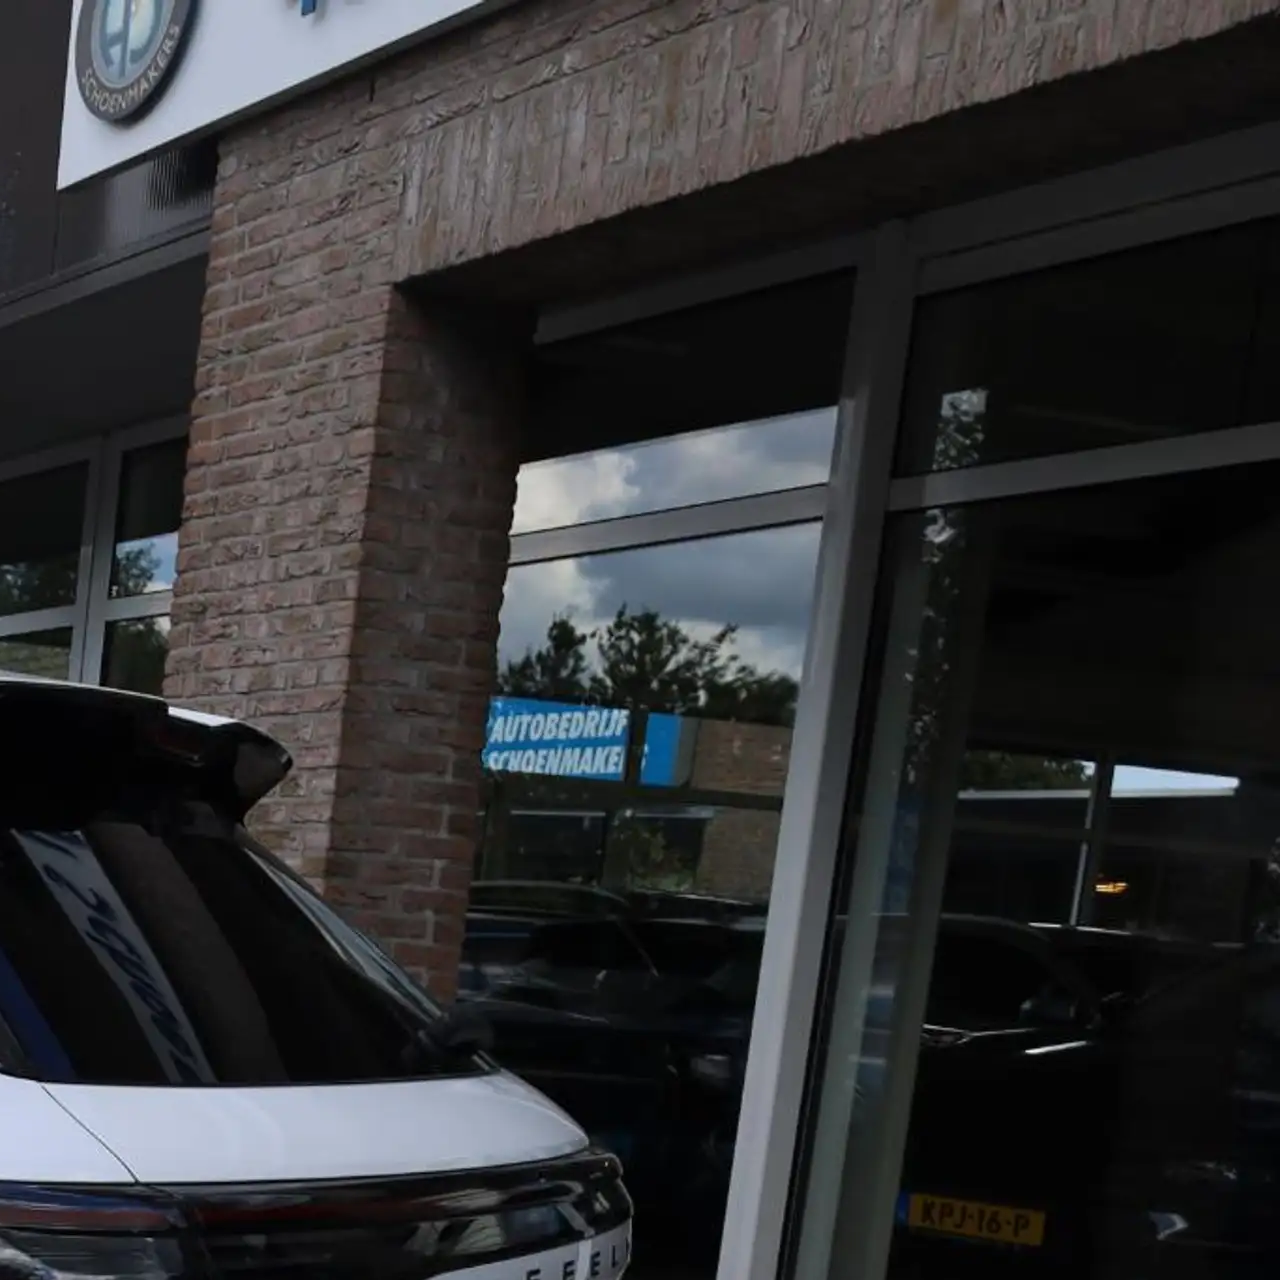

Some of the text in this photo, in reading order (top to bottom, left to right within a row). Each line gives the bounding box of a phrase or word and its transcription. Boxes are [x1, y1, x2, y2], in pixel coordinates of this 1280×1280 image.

[81, 24, 181, 114] SCHOENMAKERS
[488, 708, 630, 743] AUTOBEDRIJF
[485, 744, 649, 776] SCHOENMAKE
[920, 1198, 1030, 1239] KPJ-16-P
